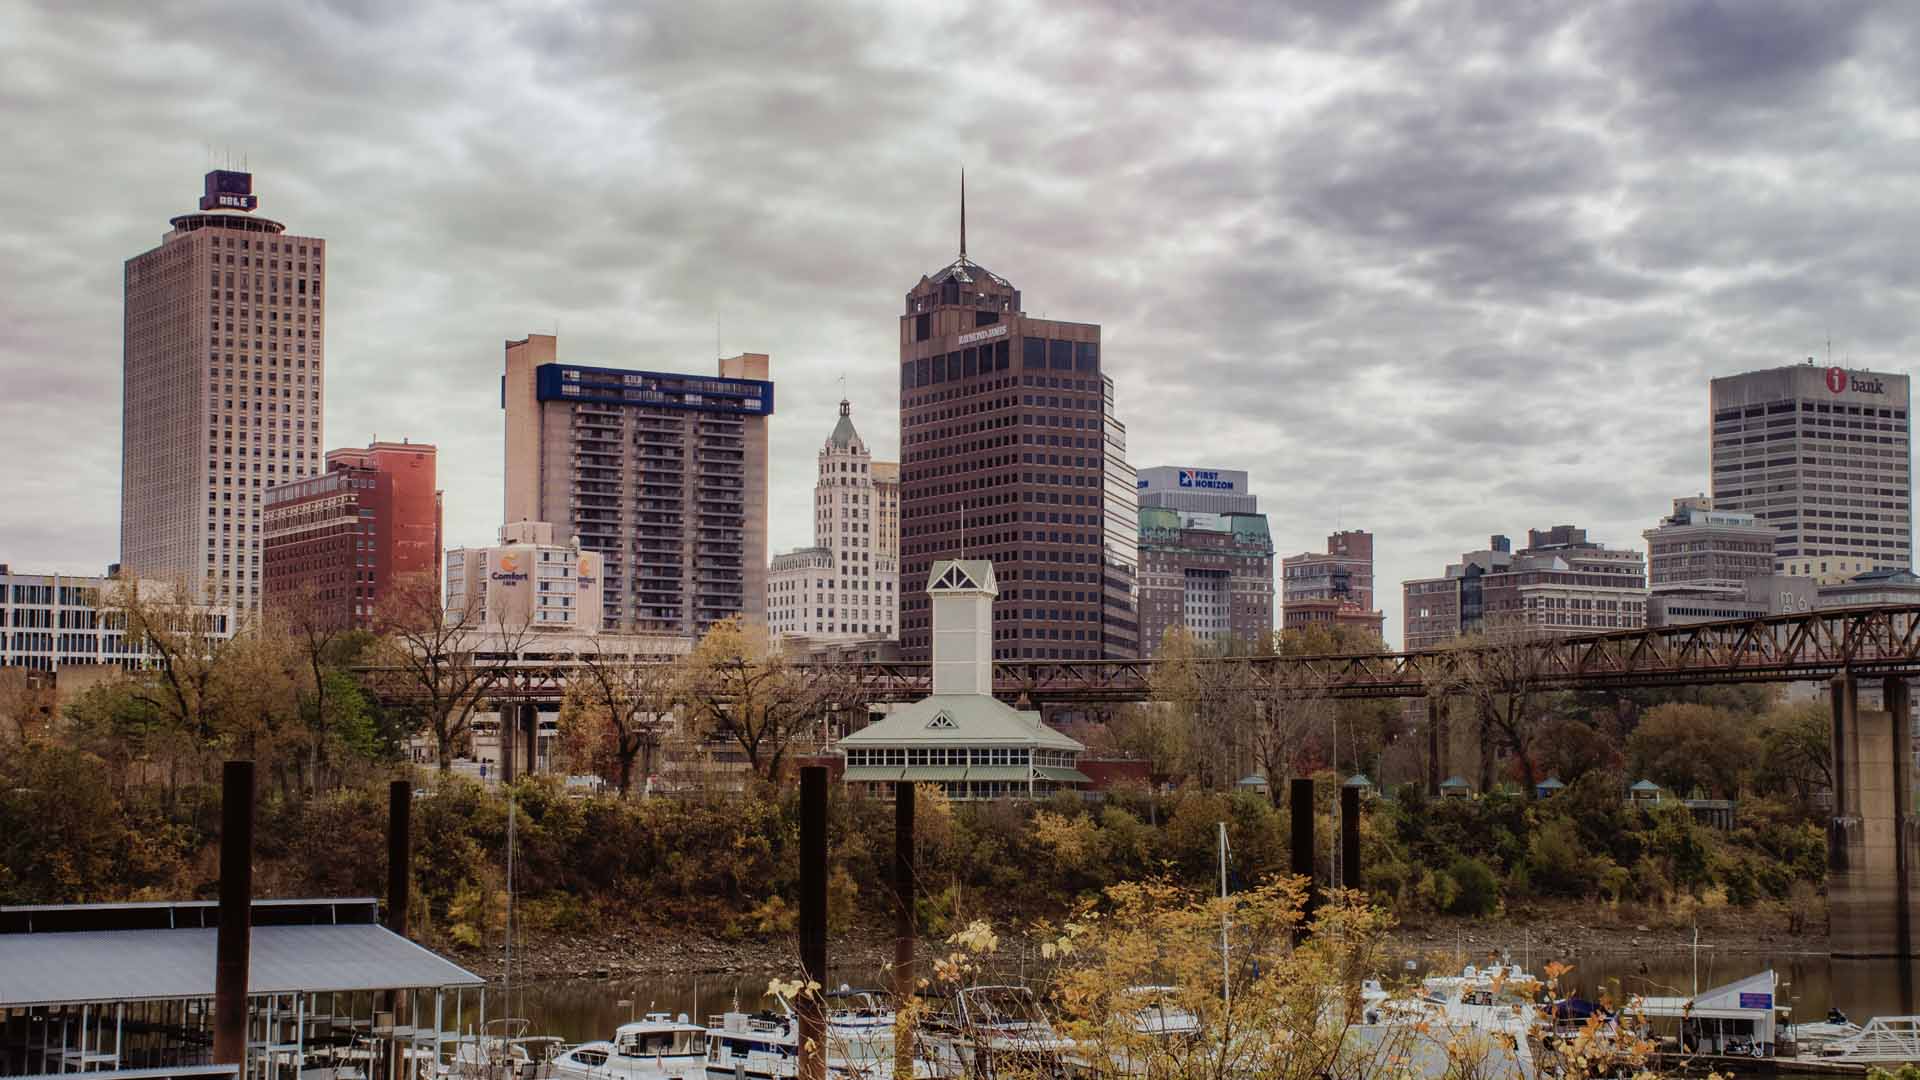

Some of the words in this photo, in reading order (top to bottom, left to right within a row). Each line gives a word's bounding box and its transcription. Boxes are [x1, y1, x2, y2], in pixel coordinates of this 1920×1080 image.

[1851, 376, 1884, 394] bank
[1195, 471, 1218, 480] FIRST
[1195, 480, 1233, 489] HORIZON
[492, 572, 528, 580] Comfort
